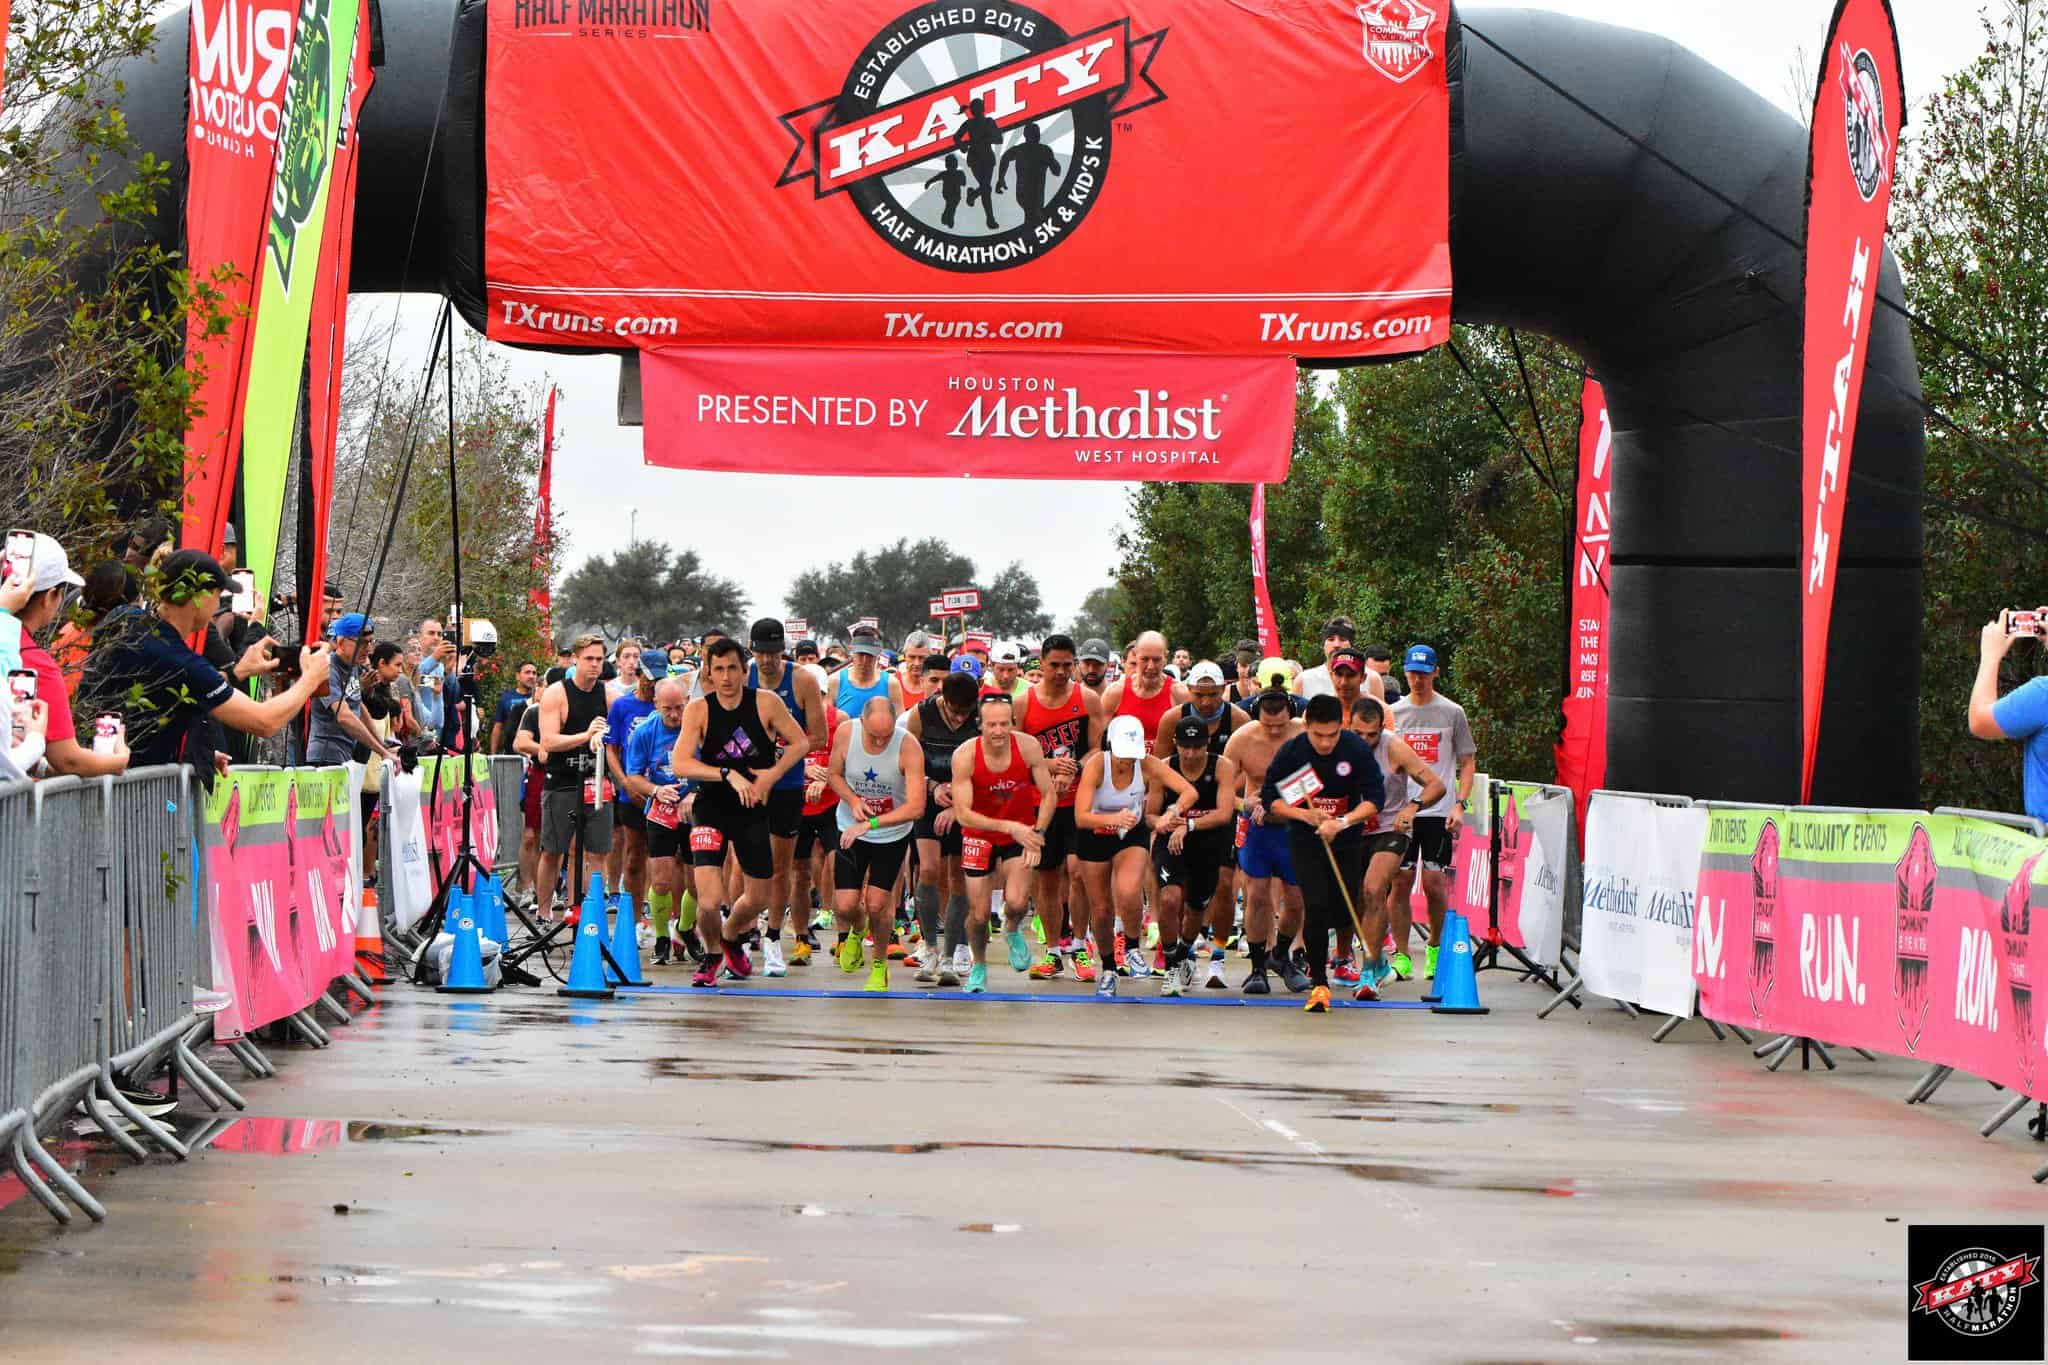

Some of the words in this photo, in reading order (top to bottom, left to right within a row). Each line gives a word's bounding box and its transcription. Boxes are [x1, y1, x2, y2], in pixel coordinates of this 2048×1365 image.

[514, 0, 571, 28] HALF
[578, 0, 711, 32] MARATHON
[578, 28, 648, 39] SERIES
[854, 7, 976, 100] ESTABLISHED
[984, 9, 1038, 38] 2015
[829, 37, 1114, 180] KATY
[871, 202, 914, 243] HALF
[914, 235, 1034, 266] MARATHON,
[1035, 217, 1063, 244] 5K
[1058, 205, 1074, 223] &
[1068, 155, 1102, 207] KID'S
[1085, 135, 1104, 150] K
[502, 299, 678, 336] TXruns.com
[884, 312, 1064, 339] TXruns.com
[1258, 312, 1433, 342] TXruns.com
[948, 376, 1056, 392] HOUSTON
[698, 394, 877, 426] PRESENTED
[889, 399, 929, 427] BY
[945, 387, 1222, 440] Methodist
[1075, 450, 1123, 464] WEST
[1132, 451, 1221, 464] HOSPITAL
[1580, 637, 1599, 648] THE
[1037, 719, 1080, 754] BEEF
[1582, 875, 1638, 917] Methodist
[1696, 895, 1726, 979] N.
[1800, 913, 1866, 1005] RUN.
[1954, 926, 1999, 1033] RUN.
